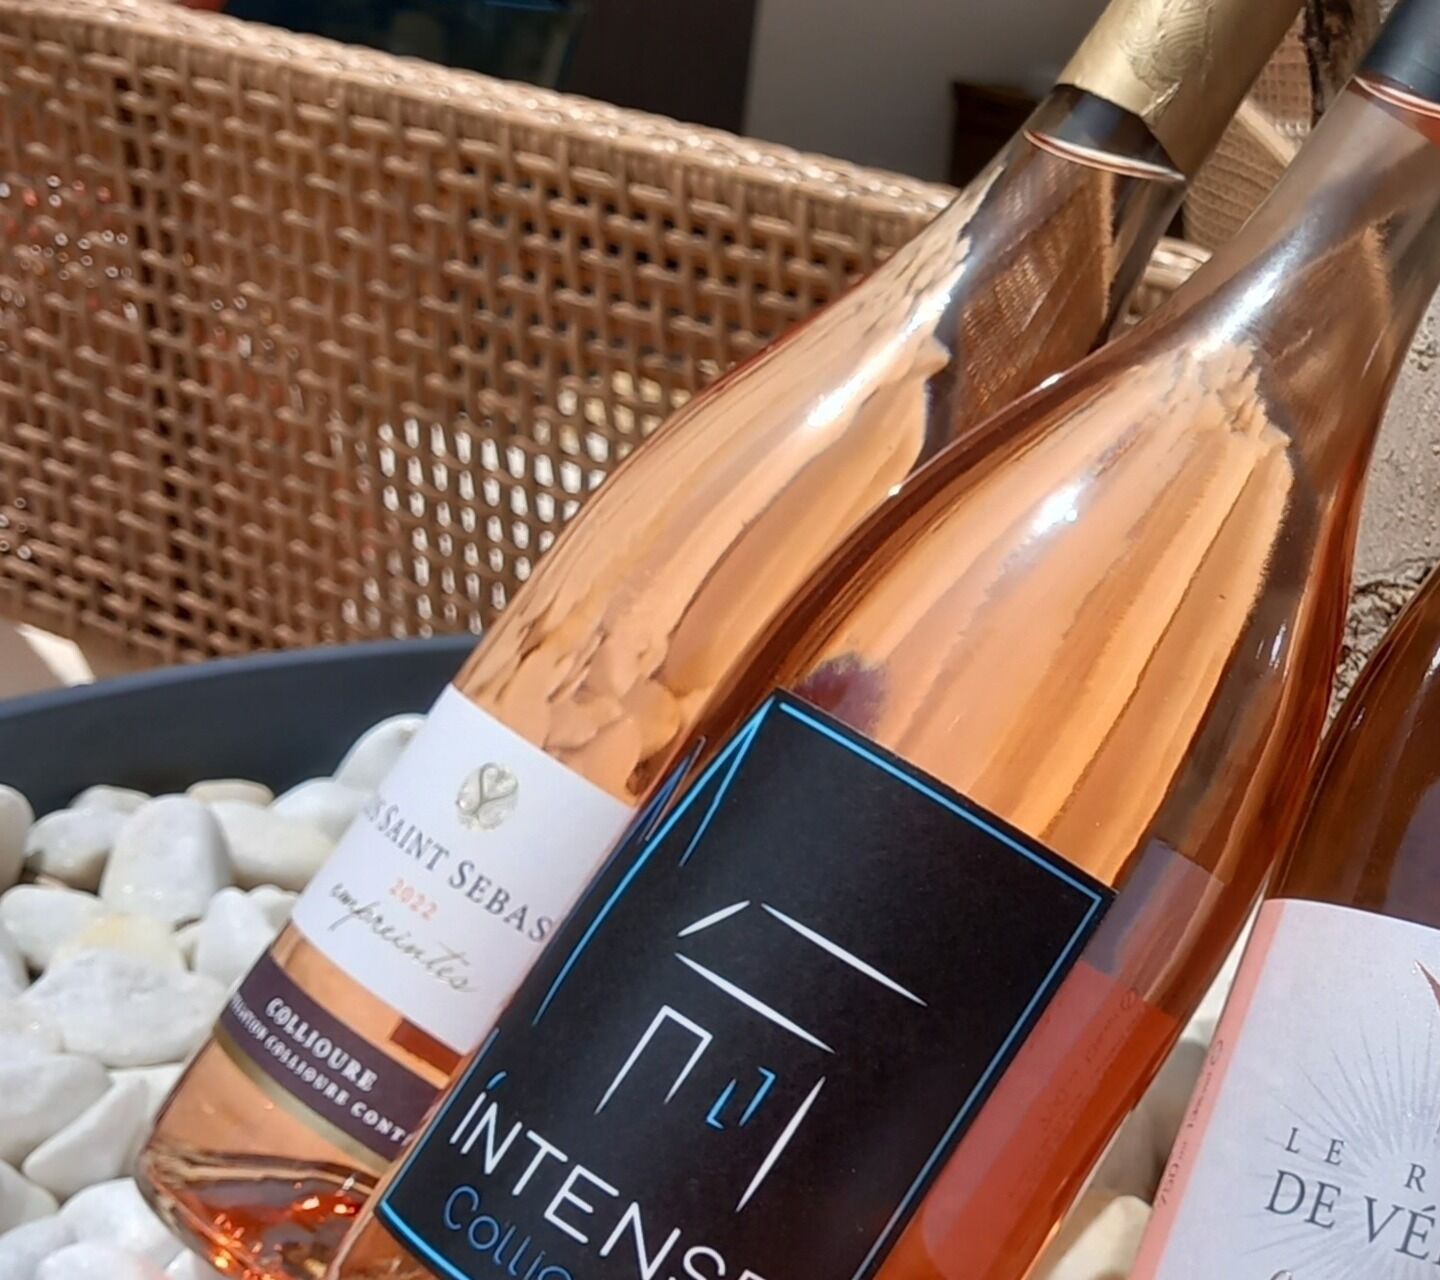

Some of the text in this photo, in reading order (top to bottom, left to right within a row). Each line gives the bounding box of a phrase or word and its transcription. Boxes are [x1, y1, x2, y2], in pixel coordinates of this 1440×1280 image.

[375, 798, 451, 874] SAINT
[386, 875, 439, 922] 2022
[330, 882, 478, 995] empreintes
[263, 995, 380, 1095] COLLIOURE
[264, 1028, 351, 1107] COLLIOURE
[350, 1098, 411, 1147] CONT
[1283, 1126, 1346, 1166] LE
[1263, 1168, 1343, 1231] DE
